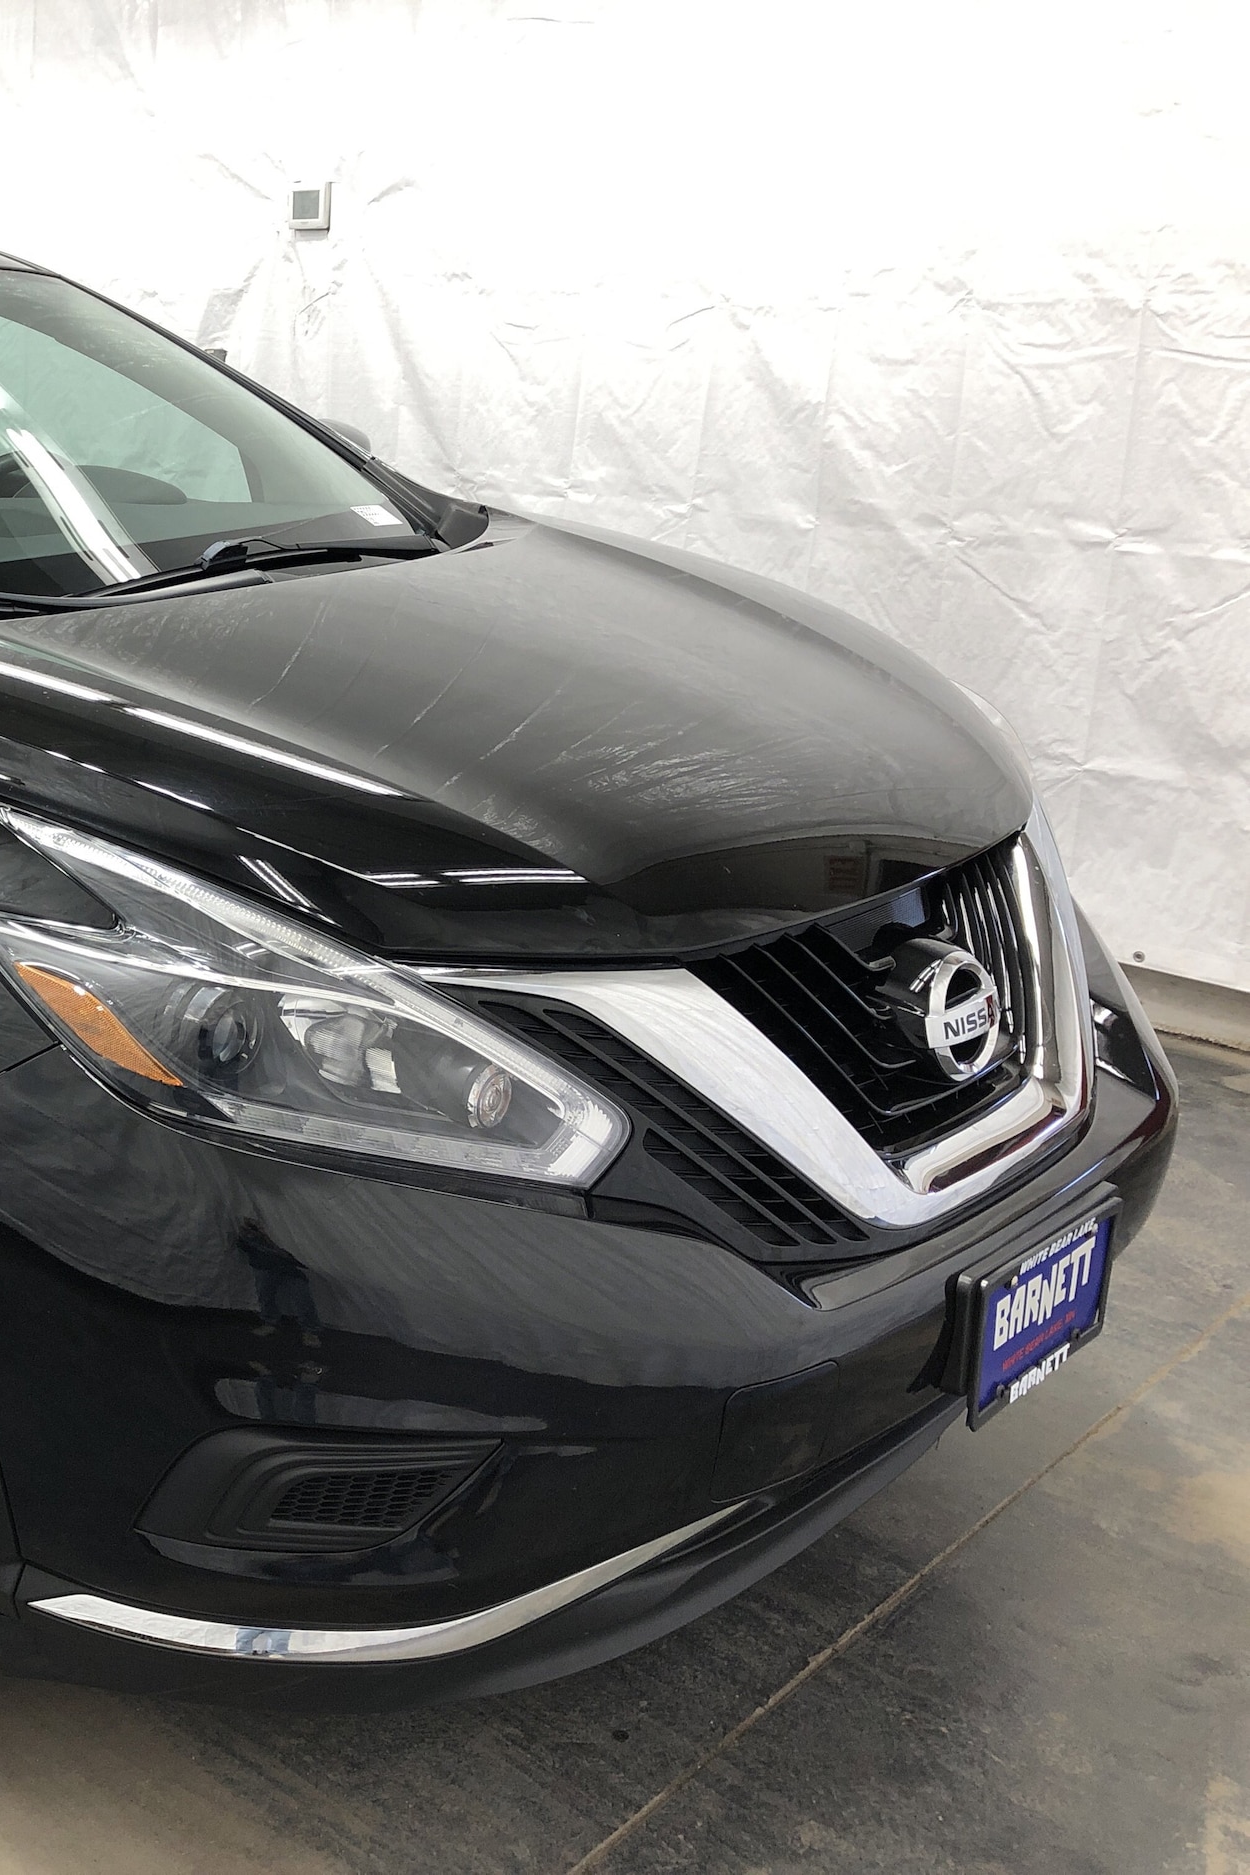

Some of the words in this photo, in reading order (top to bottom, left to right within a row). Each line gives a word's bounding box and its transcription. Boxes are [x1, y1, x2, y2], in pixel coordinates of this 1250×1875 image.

[943, 994, 998, 1040] NISSA
[1019, 1246, 1049, 1275] WHITE
[1048, 1231, 1073, 1258] BEAR
[993, 1235, 1097, 1352] BARNETT
[1009, 1342, 1071, 1405] BARNETT
